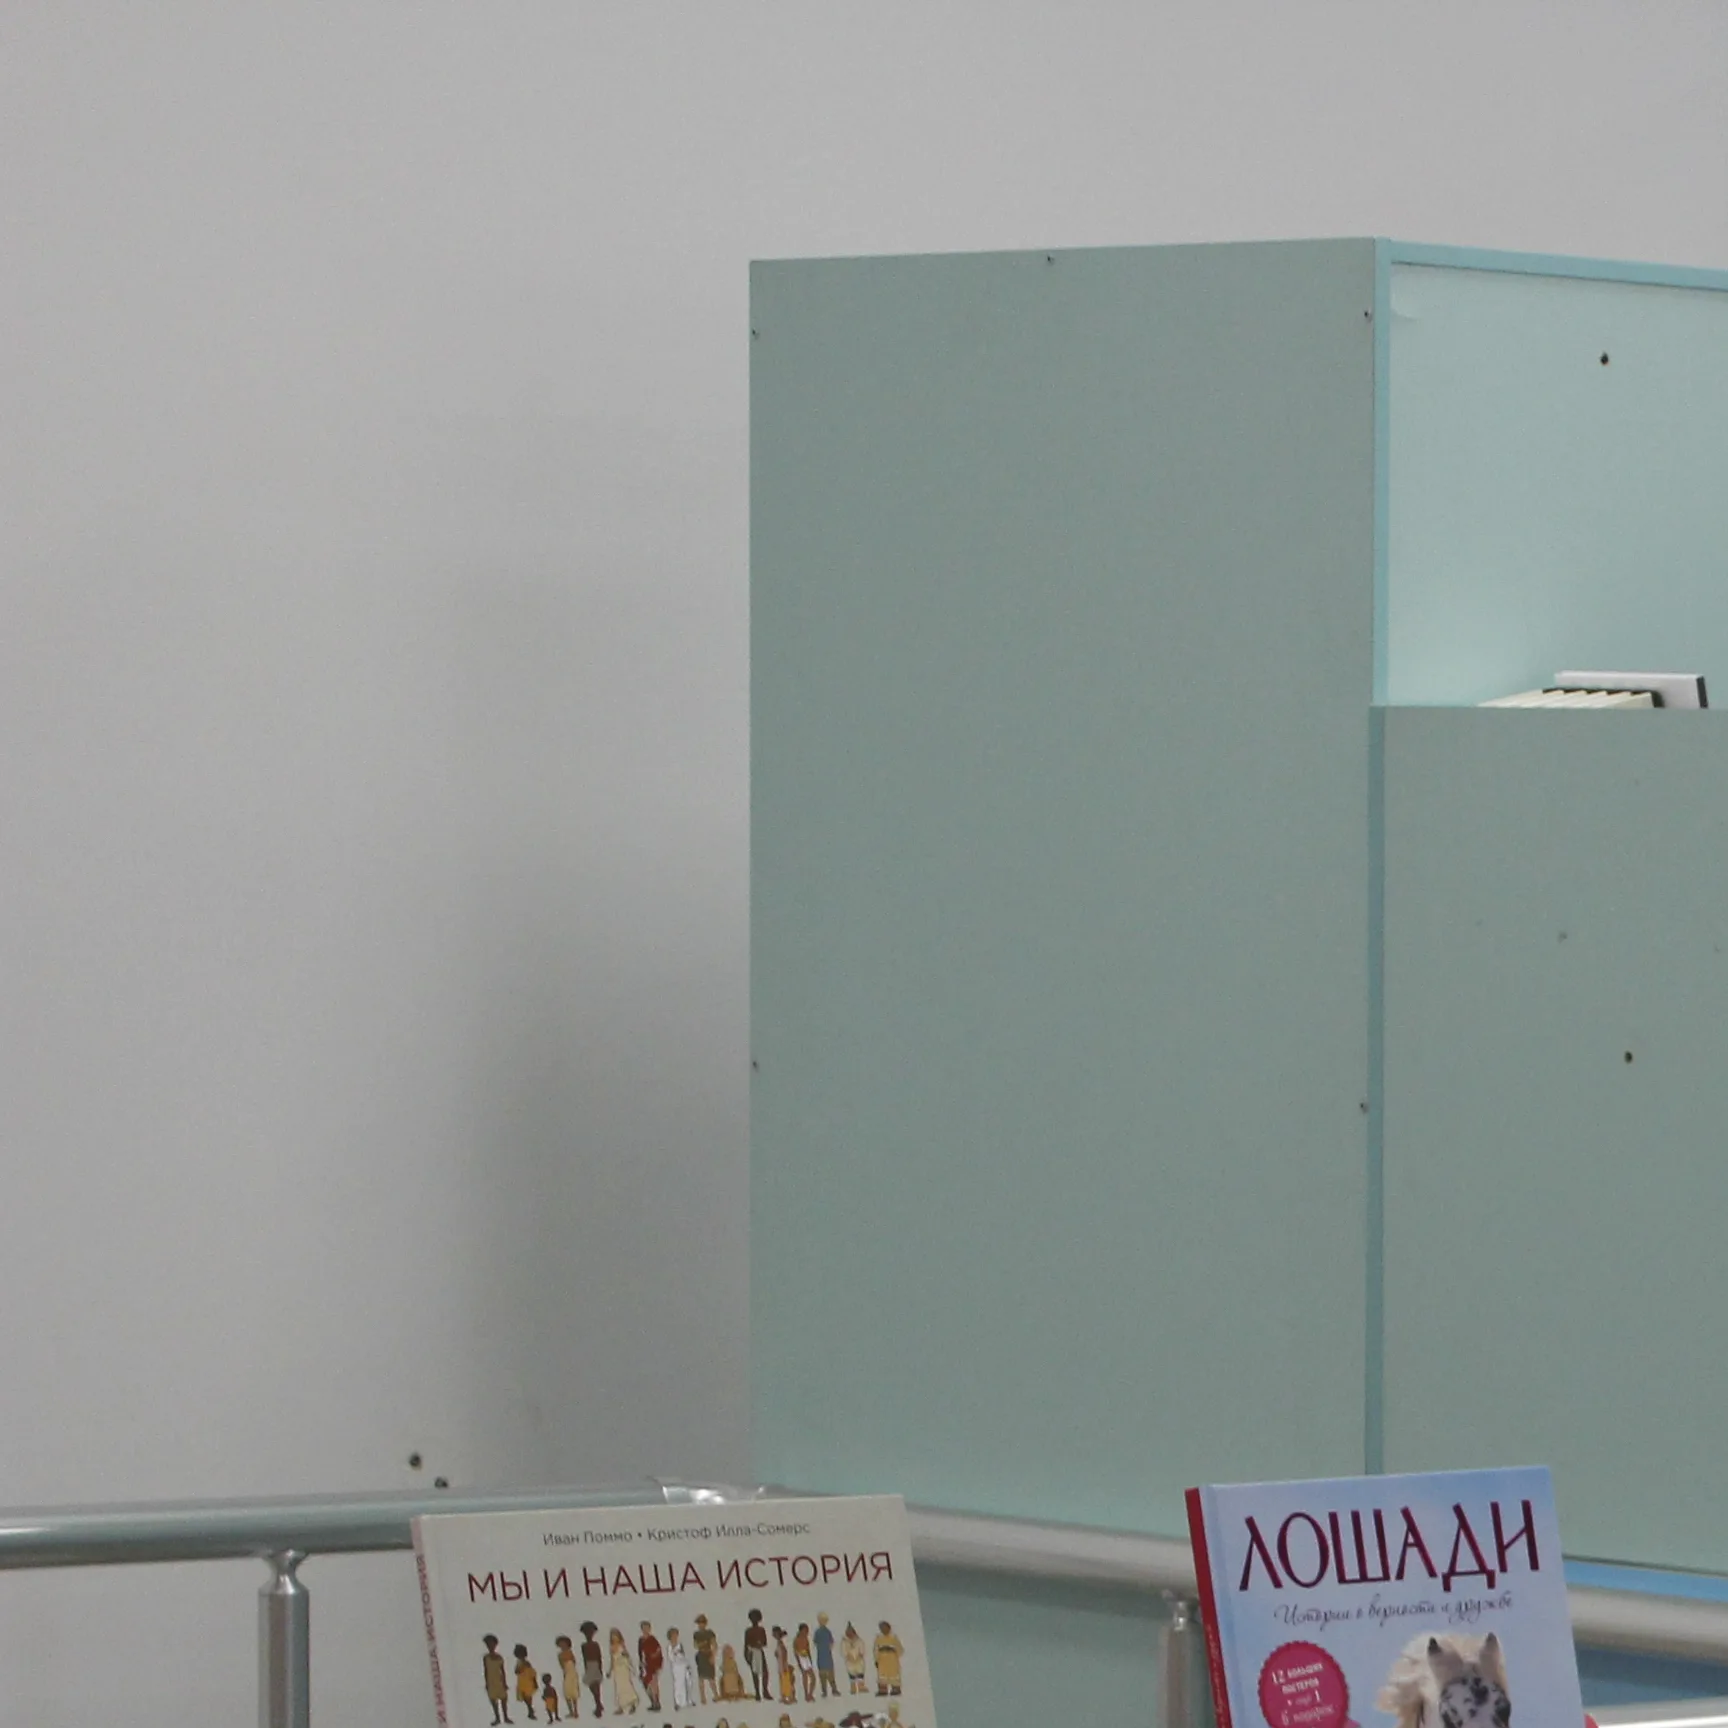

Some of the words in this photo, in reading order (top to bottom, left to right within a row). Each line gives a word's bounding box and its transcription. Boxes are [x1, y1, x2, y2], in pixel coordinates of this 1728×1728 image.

[542, 1530, 580, 1546] Иван
[583, 1529, 633, 1545] Поммо
[646, 1524, 712, 1545] Кристоф
[715, 1523, 811, 1540] Илла-Сомерс
[1238, 1500, 1541, 1592] ЛОШАДИ
[416, 1554, 436, 1642] ИСТОРИЯ
[467, 1571, 530, 1602] МЫ
[544, 1568, 570, 1599] И
[583, 1561, 705, 1597] НАША
[716, 1551, 894, 1590] ИСТОРИЯ
[1273, 1602, 1351, 1632] Истории
[1449, 1589, 1515, 1625] дружбе
[429, 1645, 444, 1704] НАША
